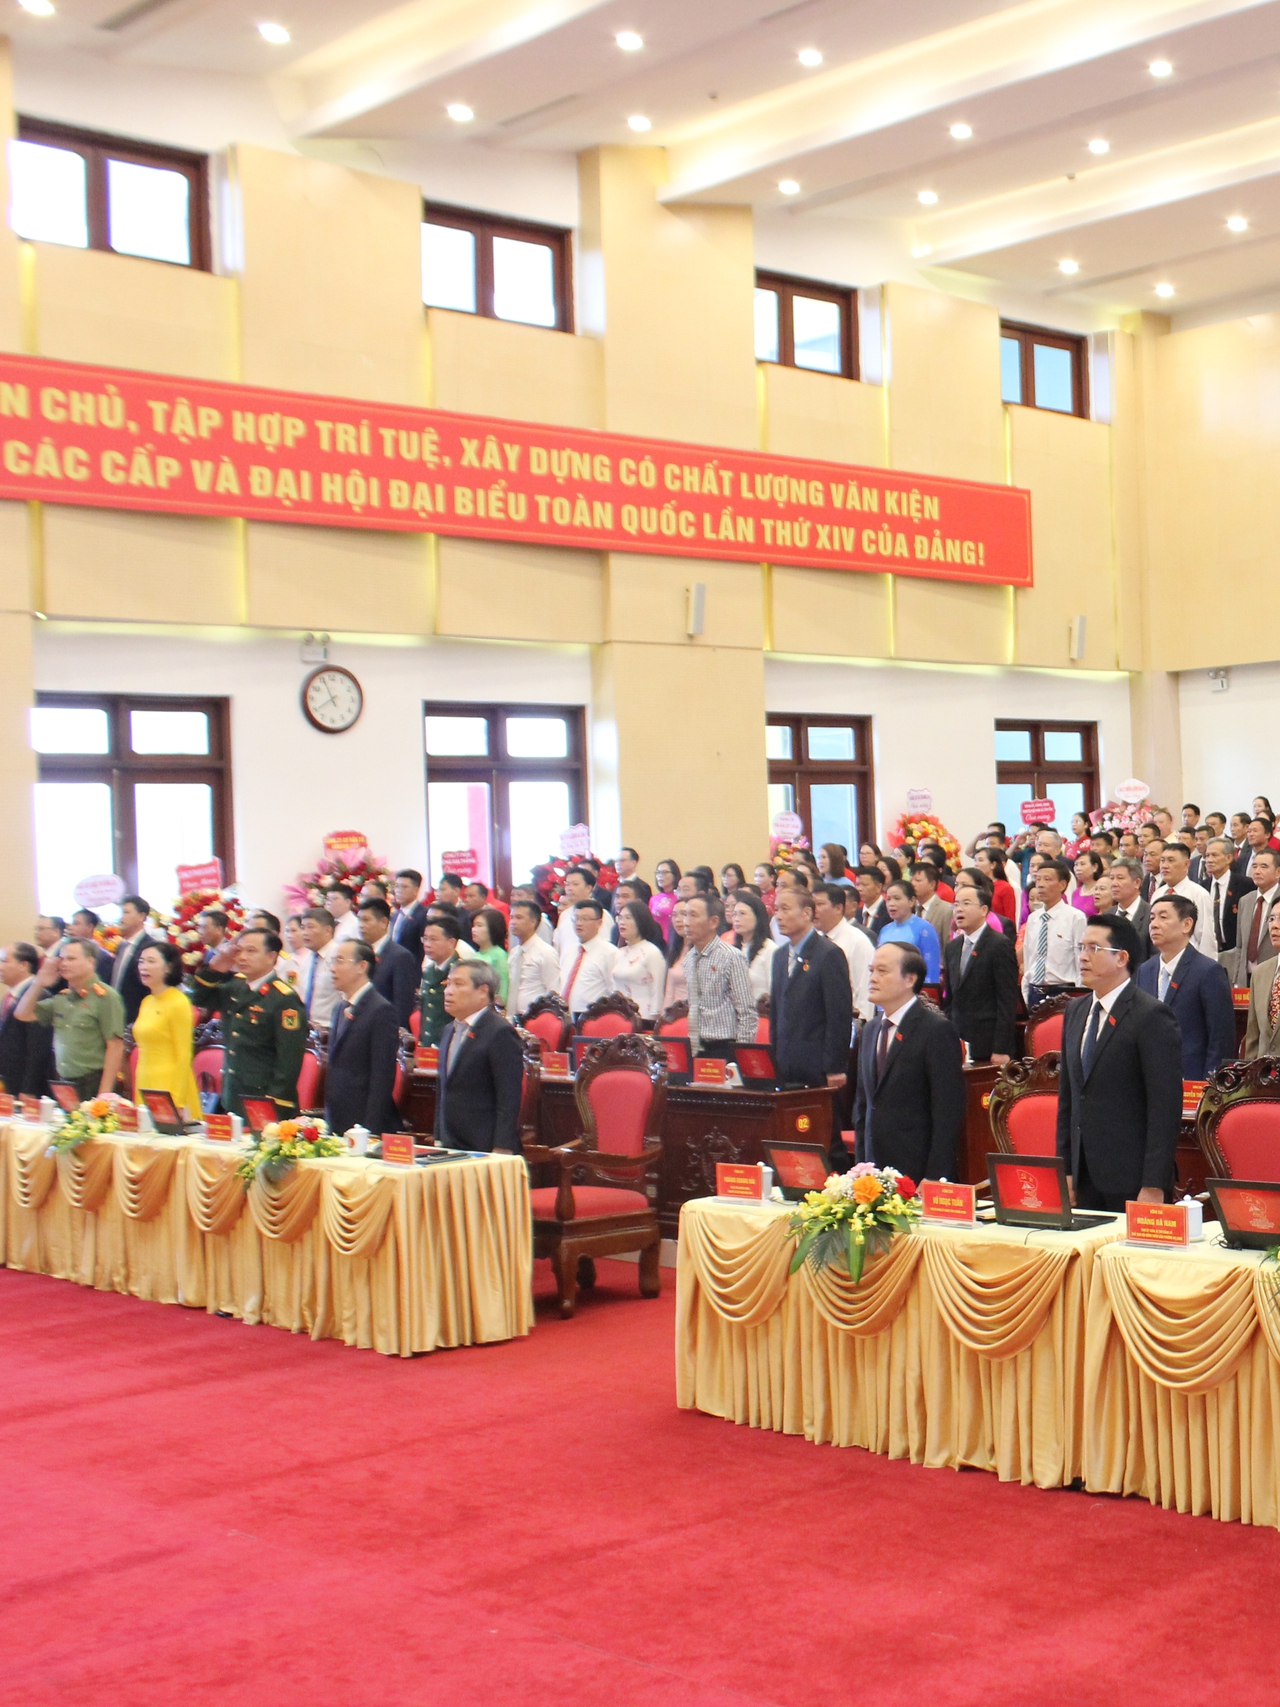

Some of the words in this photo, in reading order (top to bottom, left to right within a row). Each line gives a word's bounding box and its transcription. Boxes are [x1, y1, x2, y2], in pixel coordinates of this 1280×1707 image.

[41, 384, 139, 433] CHỦ,
[148, 397, 221, 441] TẬP
[233, 410, 304, 453] HỢP
[315, 418, 370, 455] TRÍ
[378, 426, 451, 468] TUỆ,
[460, 436, 518, 474] XÂY
[530, 444, 610, 484] DỰNG
[619, 456, 656, 488] CÓ
[664, 460, 732, 497] CHẤT
[740, 471, 823, 511] LƯỢNG
[831, 479, 878, 513] VĂN
[885, 487, 939, 522] KIỆN
[4, 437, 90, 481] CÁC
[101, 445, 181, 488] CẤP
[191, 457, 242, 495] VÀ
[248, 465, 312, 507] ĐẠI
[321, 473, 379, 512] HỘI
[389, 480, 445, 518] ĐẠI
[453, 479, 526, 521] BIỂU
[537, 495, 613, 529] TOÀN
[621, 498, 695, 538] QUỐC
[703, 508, 755, 544] LẦN
[761, 517, 810, 548] THỨ
[816, 523, 855, 552] XIV
[862, 523, 908, 557] CỦA
[914, 528, 985, 566] ĐẢNG!
[799, 1118, 809, 1128] 02
[1137, 1217, 1155, 1225] HOÀNG
